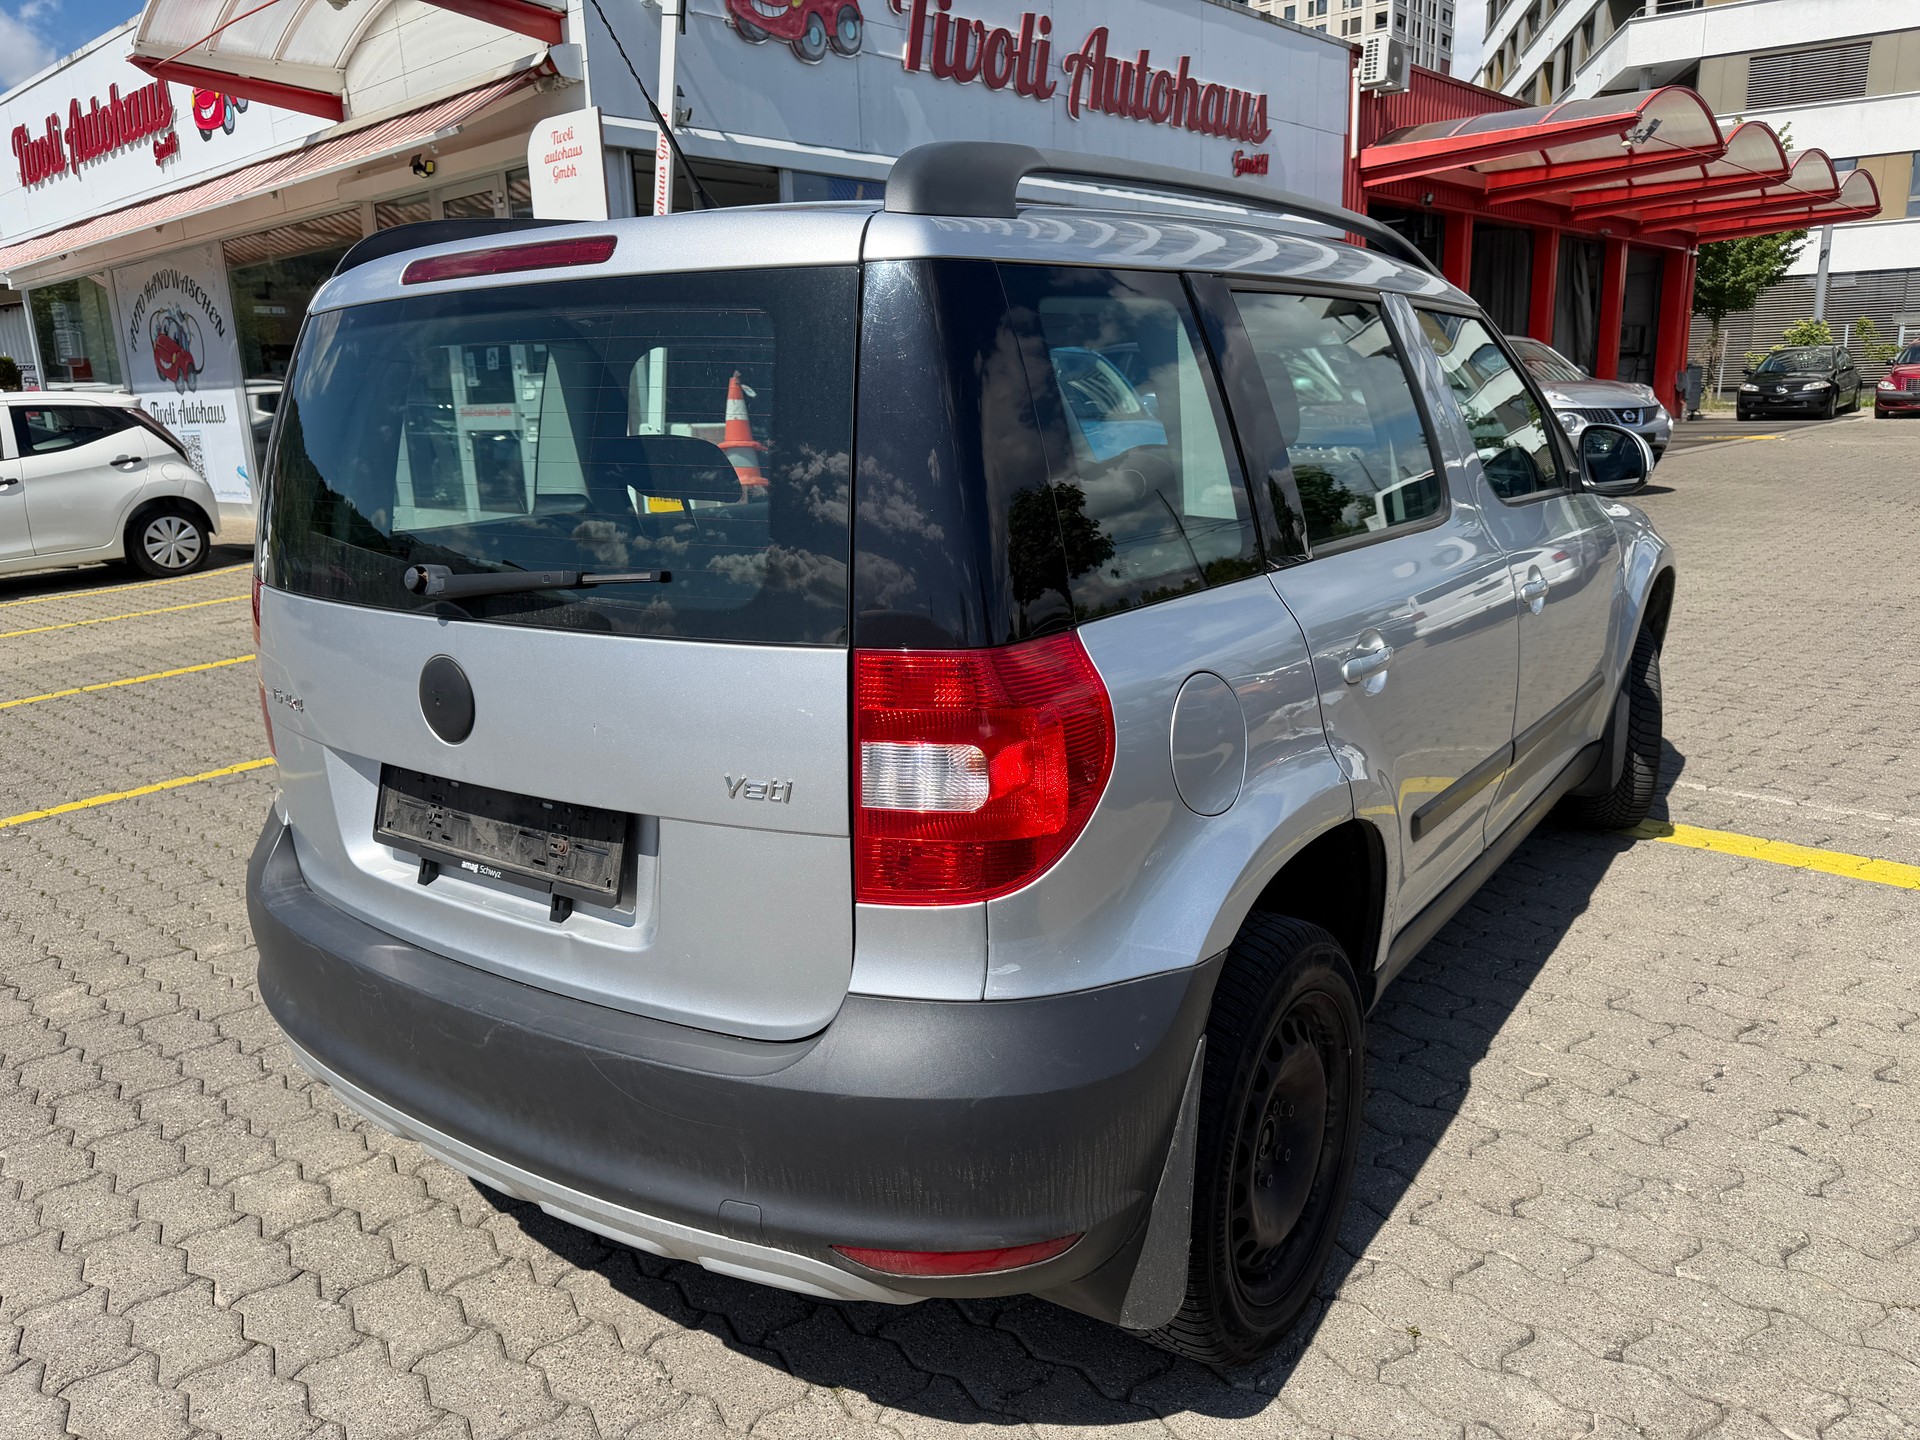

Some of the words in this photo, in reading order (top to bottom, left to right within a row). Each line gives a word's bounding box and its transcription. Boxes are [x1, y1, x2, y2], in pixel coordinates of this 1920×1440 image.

[889, 0, 1057, 101] Tivoli
[1062, 26, 1272, 145] Autohaus
[11, 112, 66, 187] Tivoli
[65, 79, 173, 176] Autohaus
[551, 126, 574, 146] Tivoli
[544, 144, 583, 165] autohaus
[130, 293, 146, 352] AUTO
[143, 268, 226, 338] HANDWASCHEN
[149, 401, 178, 426] Tivoli
[178, 399, 227, 429] Autohaus
[723, 772, 793, 805] Yeti
[461, 860, 479, 874] amag
[479, 865, 502, 879] Schwyz
